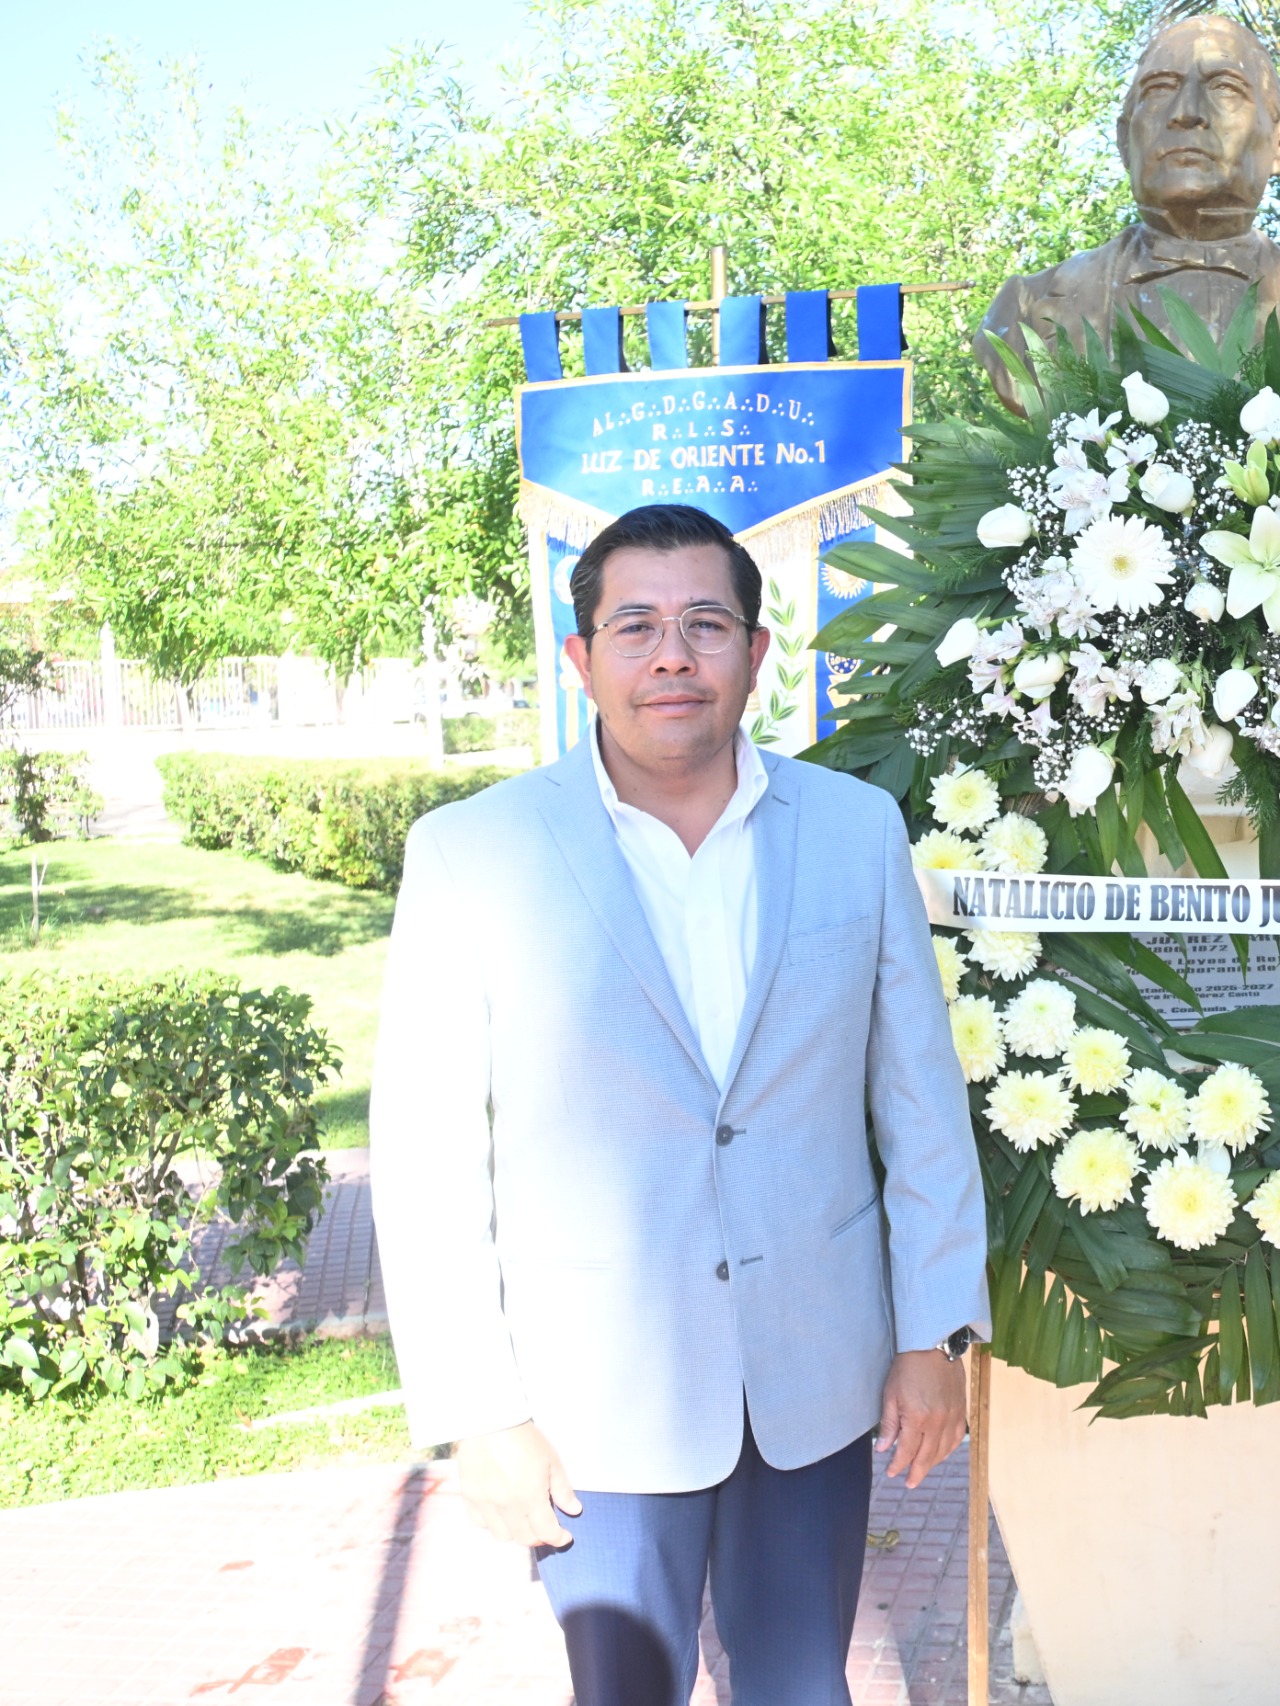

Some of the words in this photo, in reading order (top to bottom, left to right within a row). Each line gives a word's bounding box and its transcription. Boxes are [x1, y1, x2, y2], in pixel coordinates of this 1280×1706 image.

[581, 450, 623, 474] LUZ
[633, 449, 661, 471] DE
[670, 444, 765, 469] ORIENTE
[953, 876, 1096, 921] NATALICIO
[1104, 883, 1141, 921] DE
[1149, 884, 1251, 923] BENITO
